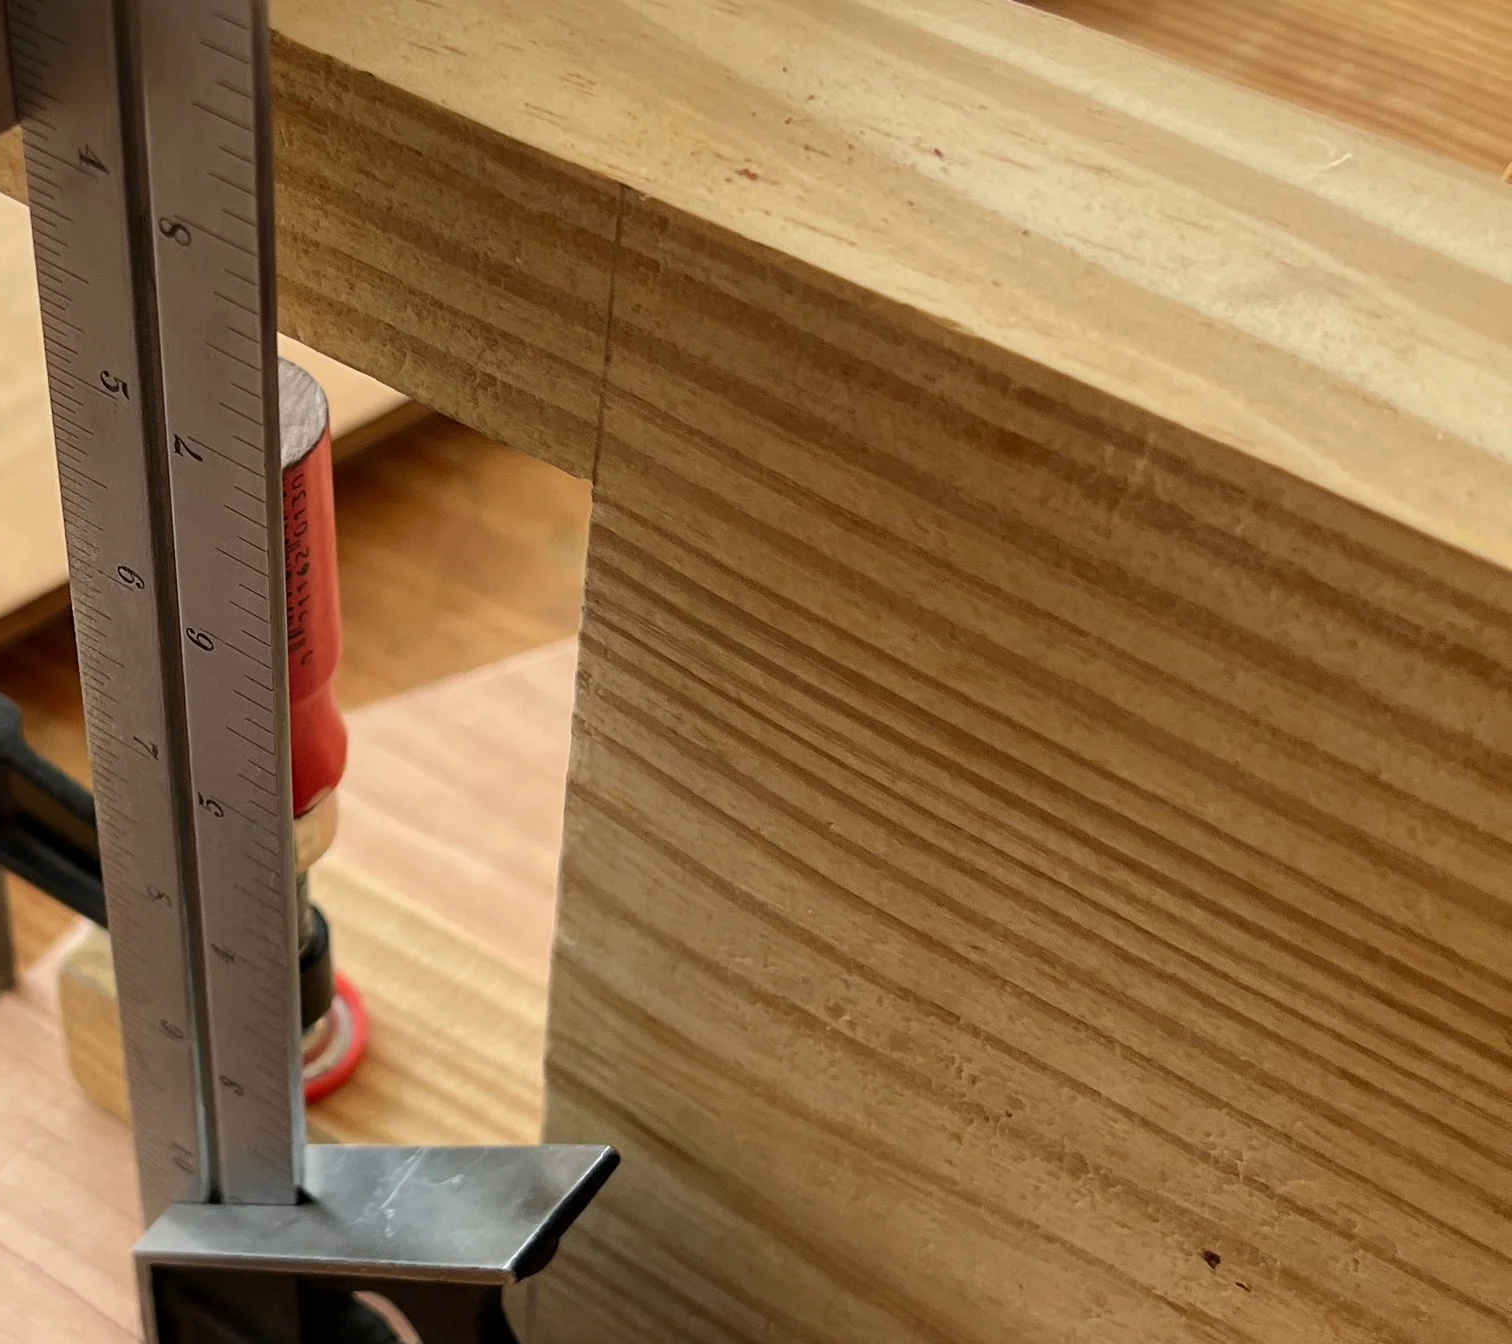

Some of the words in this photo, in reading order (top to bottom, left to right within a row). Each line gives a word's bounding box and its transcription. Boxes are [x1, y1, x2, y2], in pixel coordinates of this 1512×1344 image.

[77, 143, 110, 178] 4
[161, 215, 192, 246] 8
[99, 369, 129, 401] 5
[173, 434, 204, 462] 7
[132, 736, 159, 759] 7
[197, 792, 224, 817] 5
[147, 885, 174, 907] 8
[219, 1075, 243, 1096] 3
